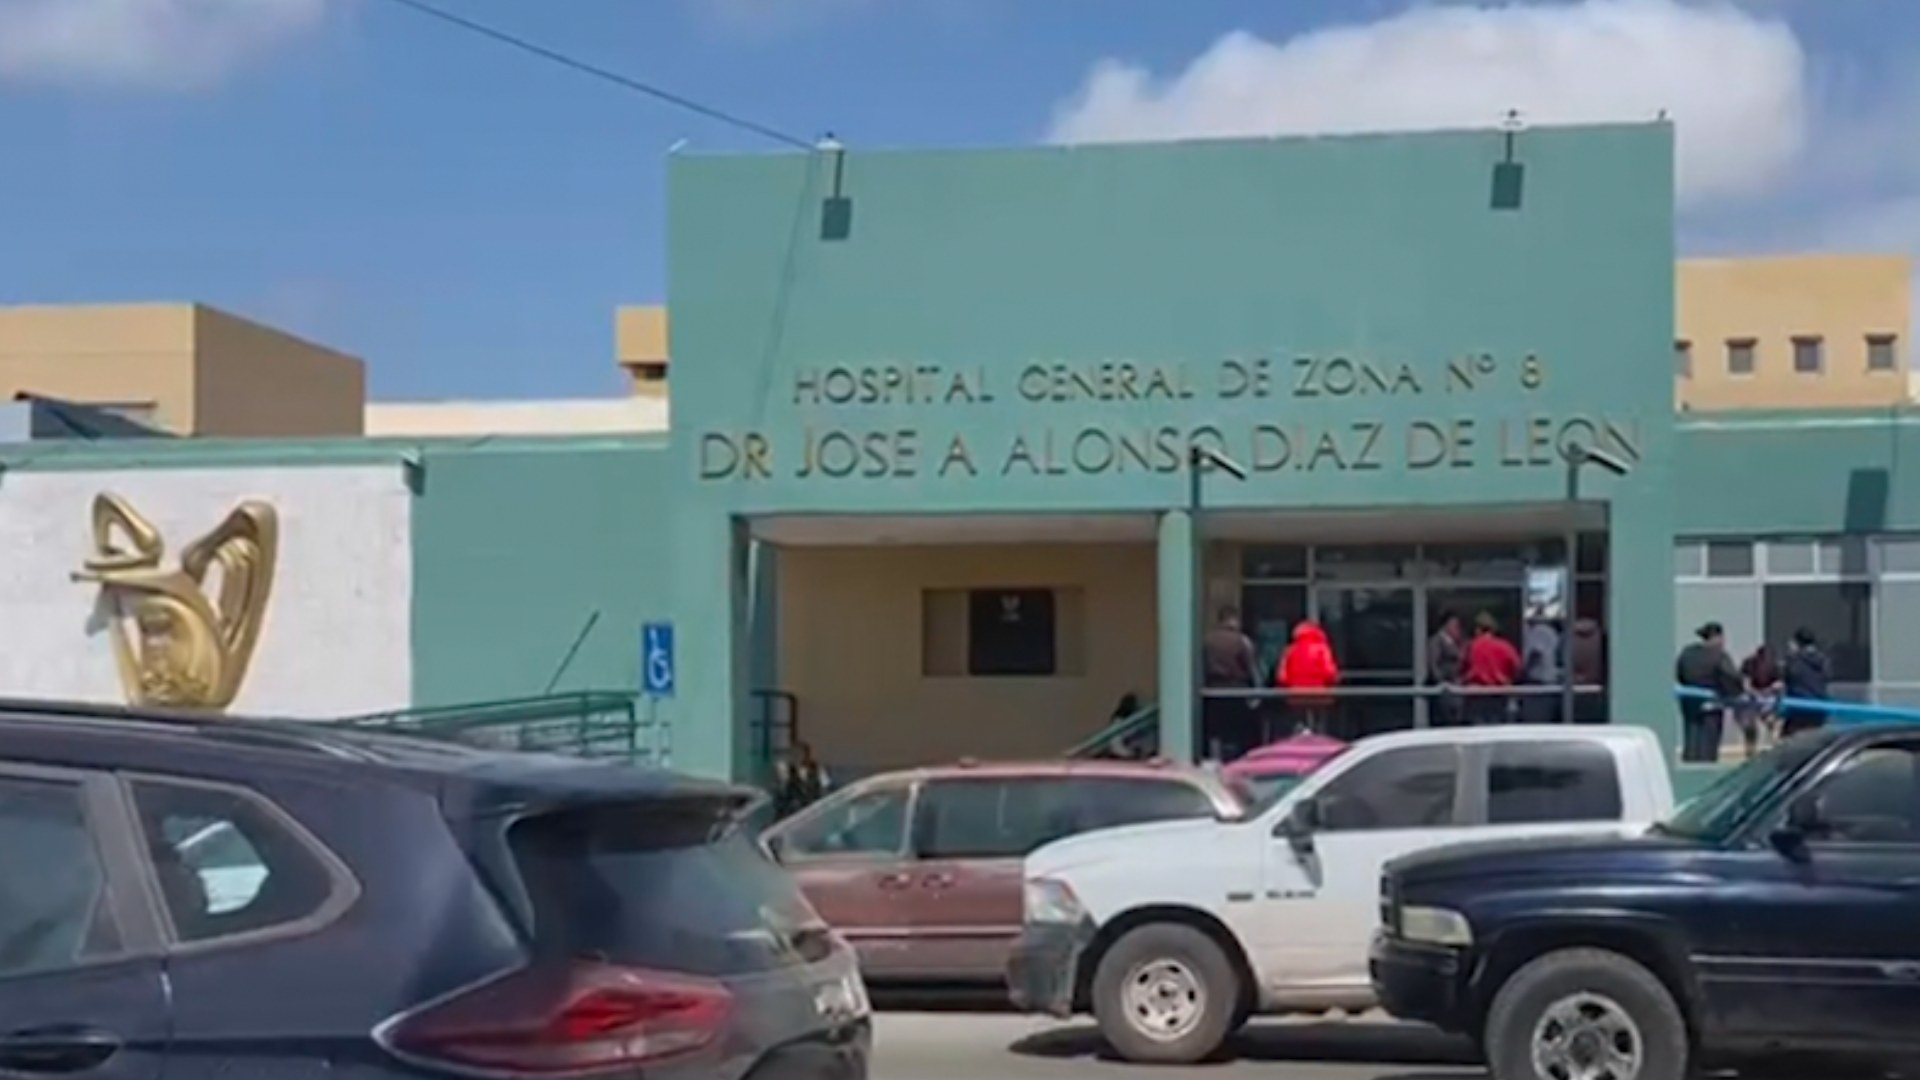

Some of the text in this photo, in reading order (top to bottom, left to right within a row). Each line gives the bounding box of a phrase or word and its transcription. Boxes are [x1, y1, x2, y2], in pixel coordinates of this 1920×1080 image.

[794, 364, 994, 404] HOSPITAL
[1219, 359, 1271, 398] DE
[1293, 356, 1422, 396] ZONA
[1520, 354, 1542, 390] 8
[700, 417, 1640, 479] DR JOSE A ALONSO DIAZ DE LEON
